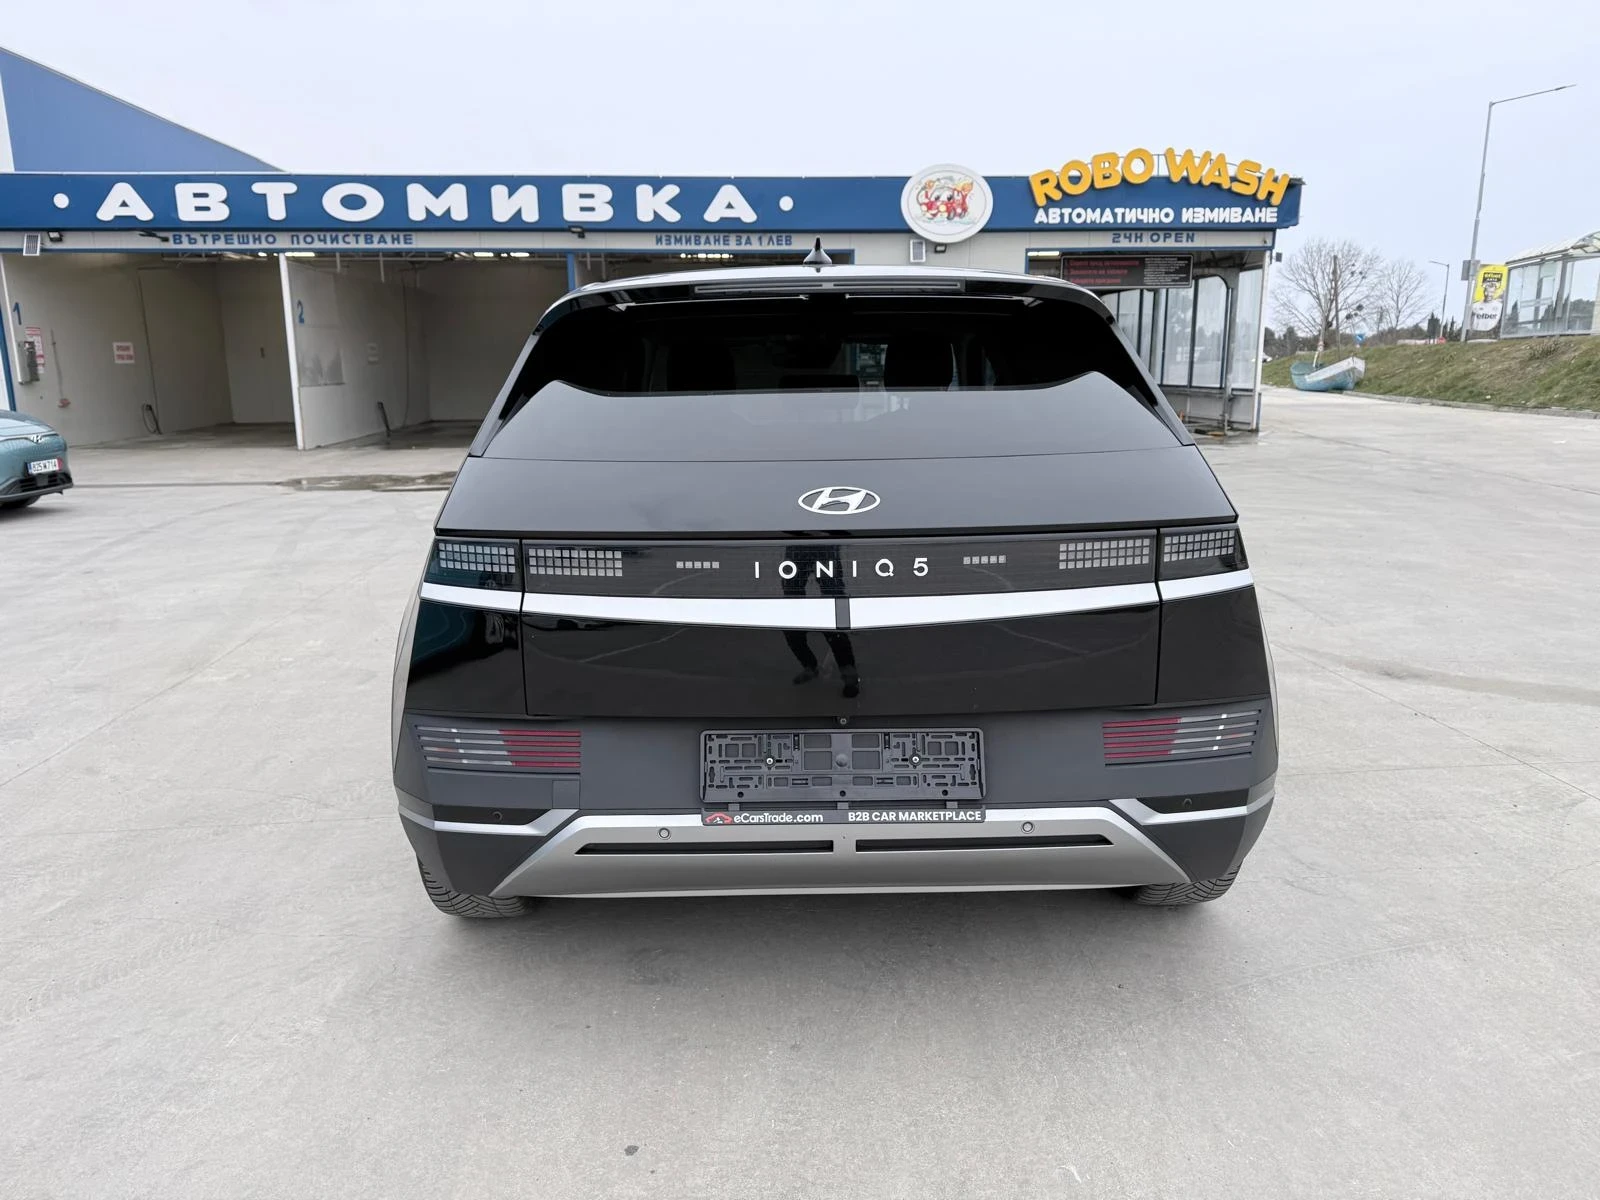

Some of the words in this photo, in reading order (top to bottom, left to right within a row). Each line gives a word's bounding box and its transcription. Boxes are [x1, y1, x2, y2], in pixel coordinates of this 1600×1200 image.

[1028, 147, 1155, 207] ROBO
[1164, 147, 1291, 206] WASH
[95, 181, 758, 223] АВТОМИВКА
[1034, 207, 1175, 224] АВТОМАТИЧНО
[1181, 207, 1278, 223] ИЗМИВАНЕ
[172, 233, 278, 246] ВЪТРЕШНО
[291, 233, 414, 246] ПОЧИСТВАНЕ
[655, 234, 731, 246] ИЗМИВАНЕ
[735, 234, 753, 246] ЗА
[766, 235, 793, 246] ЛЕВ
[1112, 232, 1144, 243] 24H
[1149, 231, 1196, 243] OPEN
[12, 302, 22, 325] 1
[297, 299, 305, 324] 2
[754, 558, 894, 579] IONIQ
[912, 557, 929, 577] 5
[733, 812, 824, 824] eCarsTrade.com
[848, 812, 870, 822] B2B
[872, 811, 896, 822] CAR
[898, 810, 982, 822] MARKETPLACE
